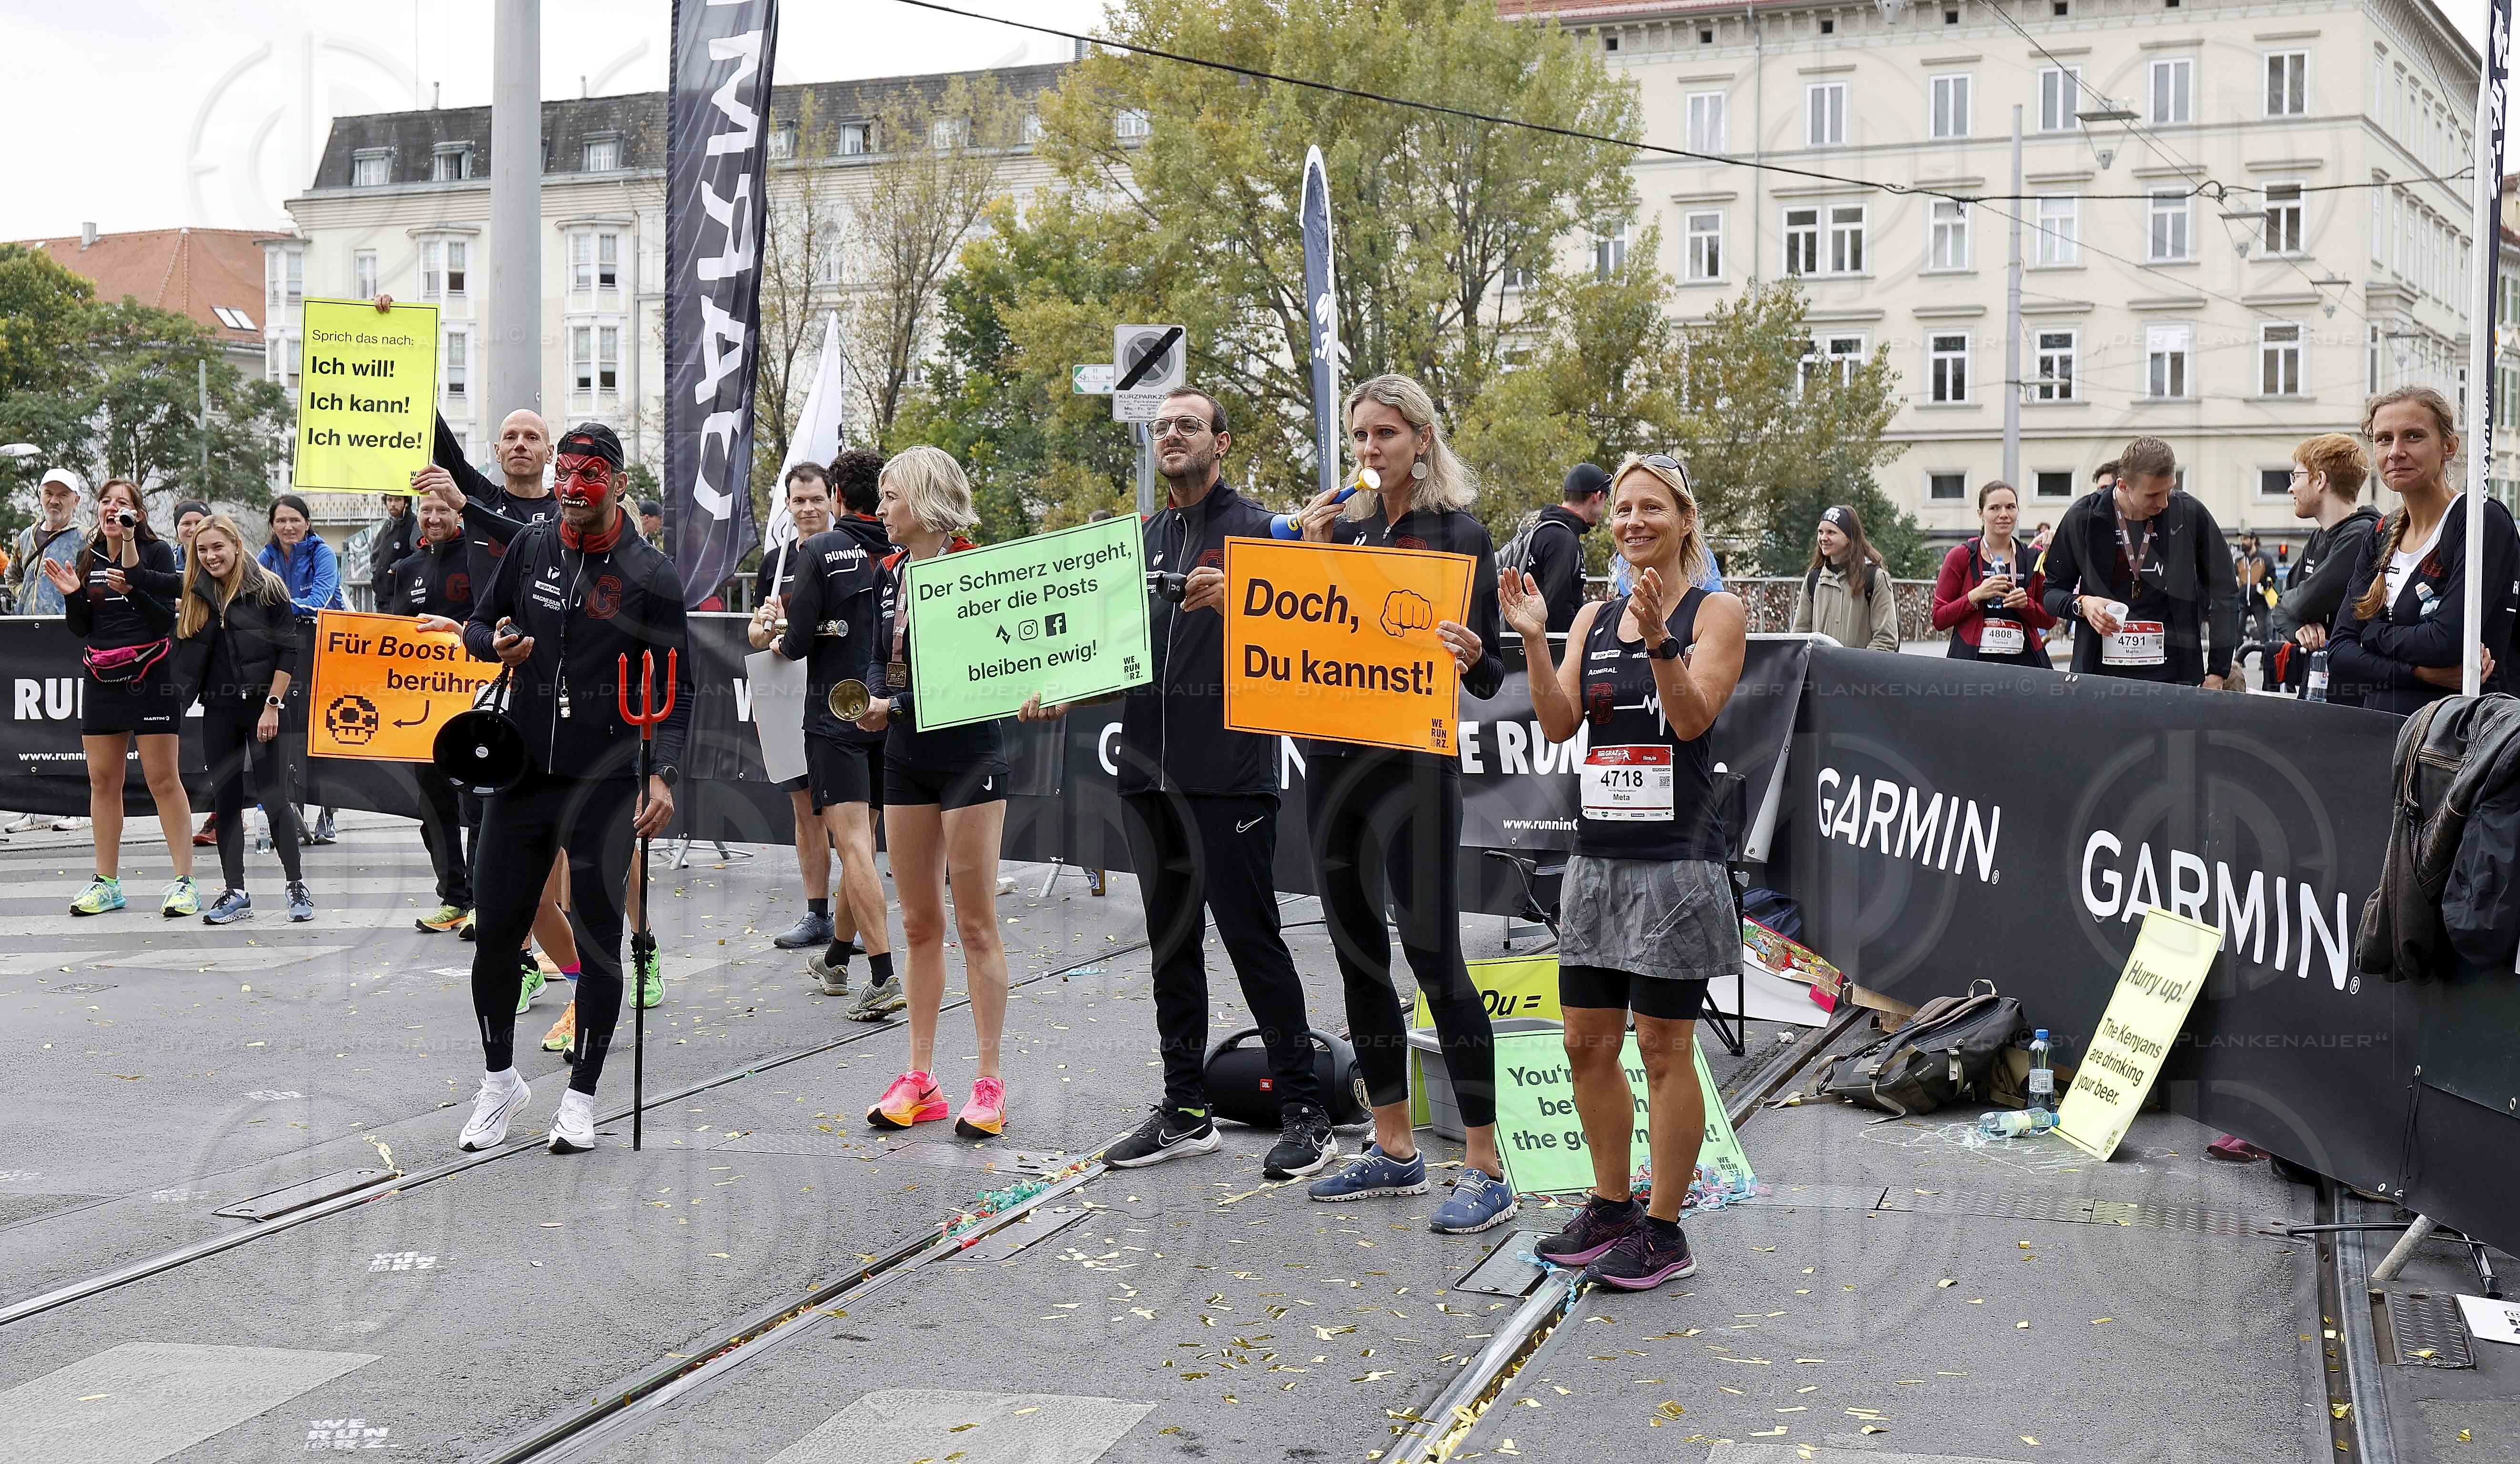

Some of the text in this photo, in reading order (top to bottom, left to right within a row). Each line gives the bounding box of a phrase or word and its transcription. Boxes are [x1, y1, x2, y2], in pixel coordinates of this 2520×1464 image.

[694, 0, 762, 519] GARM
[312, 329, 414, 346] Sprich das nach:
[311, 356, 395, 378] Ich will!
[310, 392, 410, 414] Ich kann!
[307, 427, 423, 450] Ich werde!
[825, 547, 868, 564] RUNNIN
[919, 541, 1132, 601] Der Schmerz vergeht,
[532, 593, 561, 607] MAGNESIUM
[957, 577, 1099, 619] aber die Posts
[1243, 578, 1359, 634] Doch,
[1989, 629, 2012, 639] 4808
[2118, 635, 2146, 646] 4791
[328, 632, 372, 655] Für
[377, 636, 457, 661] Boost
[968, 640, 1097, 682] bleiben ewig!
[1123, 656, 1136, 664] WE
[1123, 663, 1141, 673] RUN
[1244, 644, 1434, 696] Du kannst!
[387, 668, 491, 692] berühre
[1587, 667, 1618, 677] ADMIRAL
[14, 678, 84, 720] RU
[1431, 719, 1443, 728] WE
[1431, 728, 1447, 738] RUN
[1600, 770, 1643, 787] 4718
[2125, 960, 2192, 1003] Hurry up!
[2102, 1017, 2163, 1058] The Kenyans
[2089, 1047, 2144, 1087] are drinking
[2075, 1074, 2120, 1106] your beer.
[1513, 1131, 1556, 1149] the
